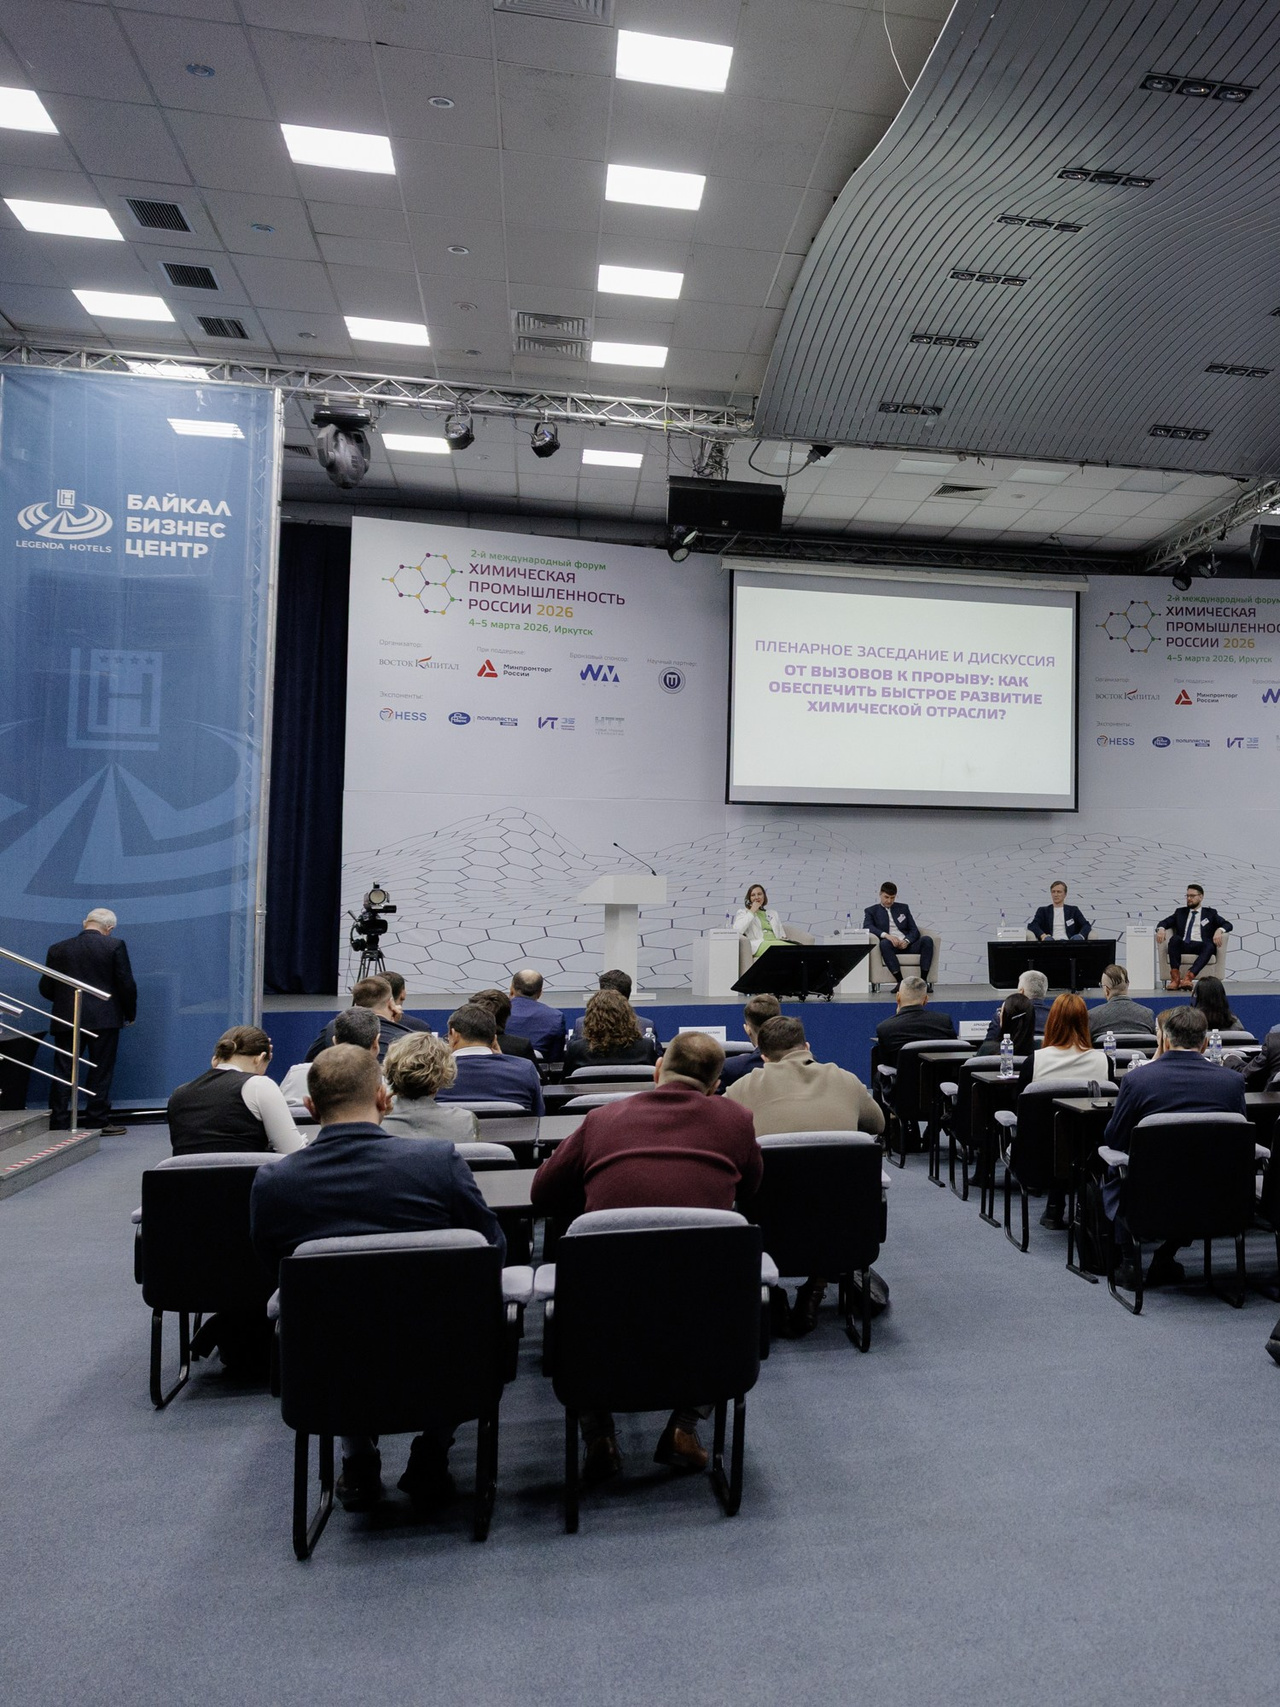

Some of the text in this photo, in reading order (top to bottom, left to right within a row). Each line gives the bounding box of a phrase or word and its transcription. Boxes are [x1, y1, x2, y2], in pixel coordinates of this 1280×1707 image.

[127, 492, 232, 516] БАЙКАЛ
[126, 516, 226, 538] БИЗНЕС
[16, 540, 112, 554] LEGENDA HOTELS
[125, 538, 208, 558] ЦЕНТР
[470, 550, 606, 570] 2-й международный форум
[469, 563, 576, 584] ХИМИЧЕСКАЯ
[469, 580, 626, 605] ПРОМЫШЛЕННОСТЬ
[1182, 596, 1252, 604] международный
[468, 598, 574, 618] РОССИИ 2026
[1166, 606, 1256, 618] ХИМИЧЕСКАЯ
[490, 621, 520, 631] марта
[524, 622, 550, 633] 2026,
[554, 625, 592, 636] Иркутск
[1166, 637, 1255, 648] РОССИИ 2026
[379, 658, 414, 668] ВОСТОК
[755, 640, 1055, 668] ПЛЕНАРНОЕ ЗАСЕДАНИЕ И ДИСКУССИЯ
[1212, 656, 1236, 664] 2026,
[1239, 656, 1272, 664] Иркутск
[504, 664, 552, 674] Минпромторг
[784, 664, 1029, 688] ОТ ВЫЗОВОВ К ПРОРЫВУ: КАК
[768, 681, 1042, 705] ОБЕСПЕЧИТЬ БЫСТРОЕ РАЗВИТИЕ
[395, 712, 427, 720] HESS
[807, 700, 1006, 720] ХИМИЧЕСКОЙ ОТРАСЛИ?
